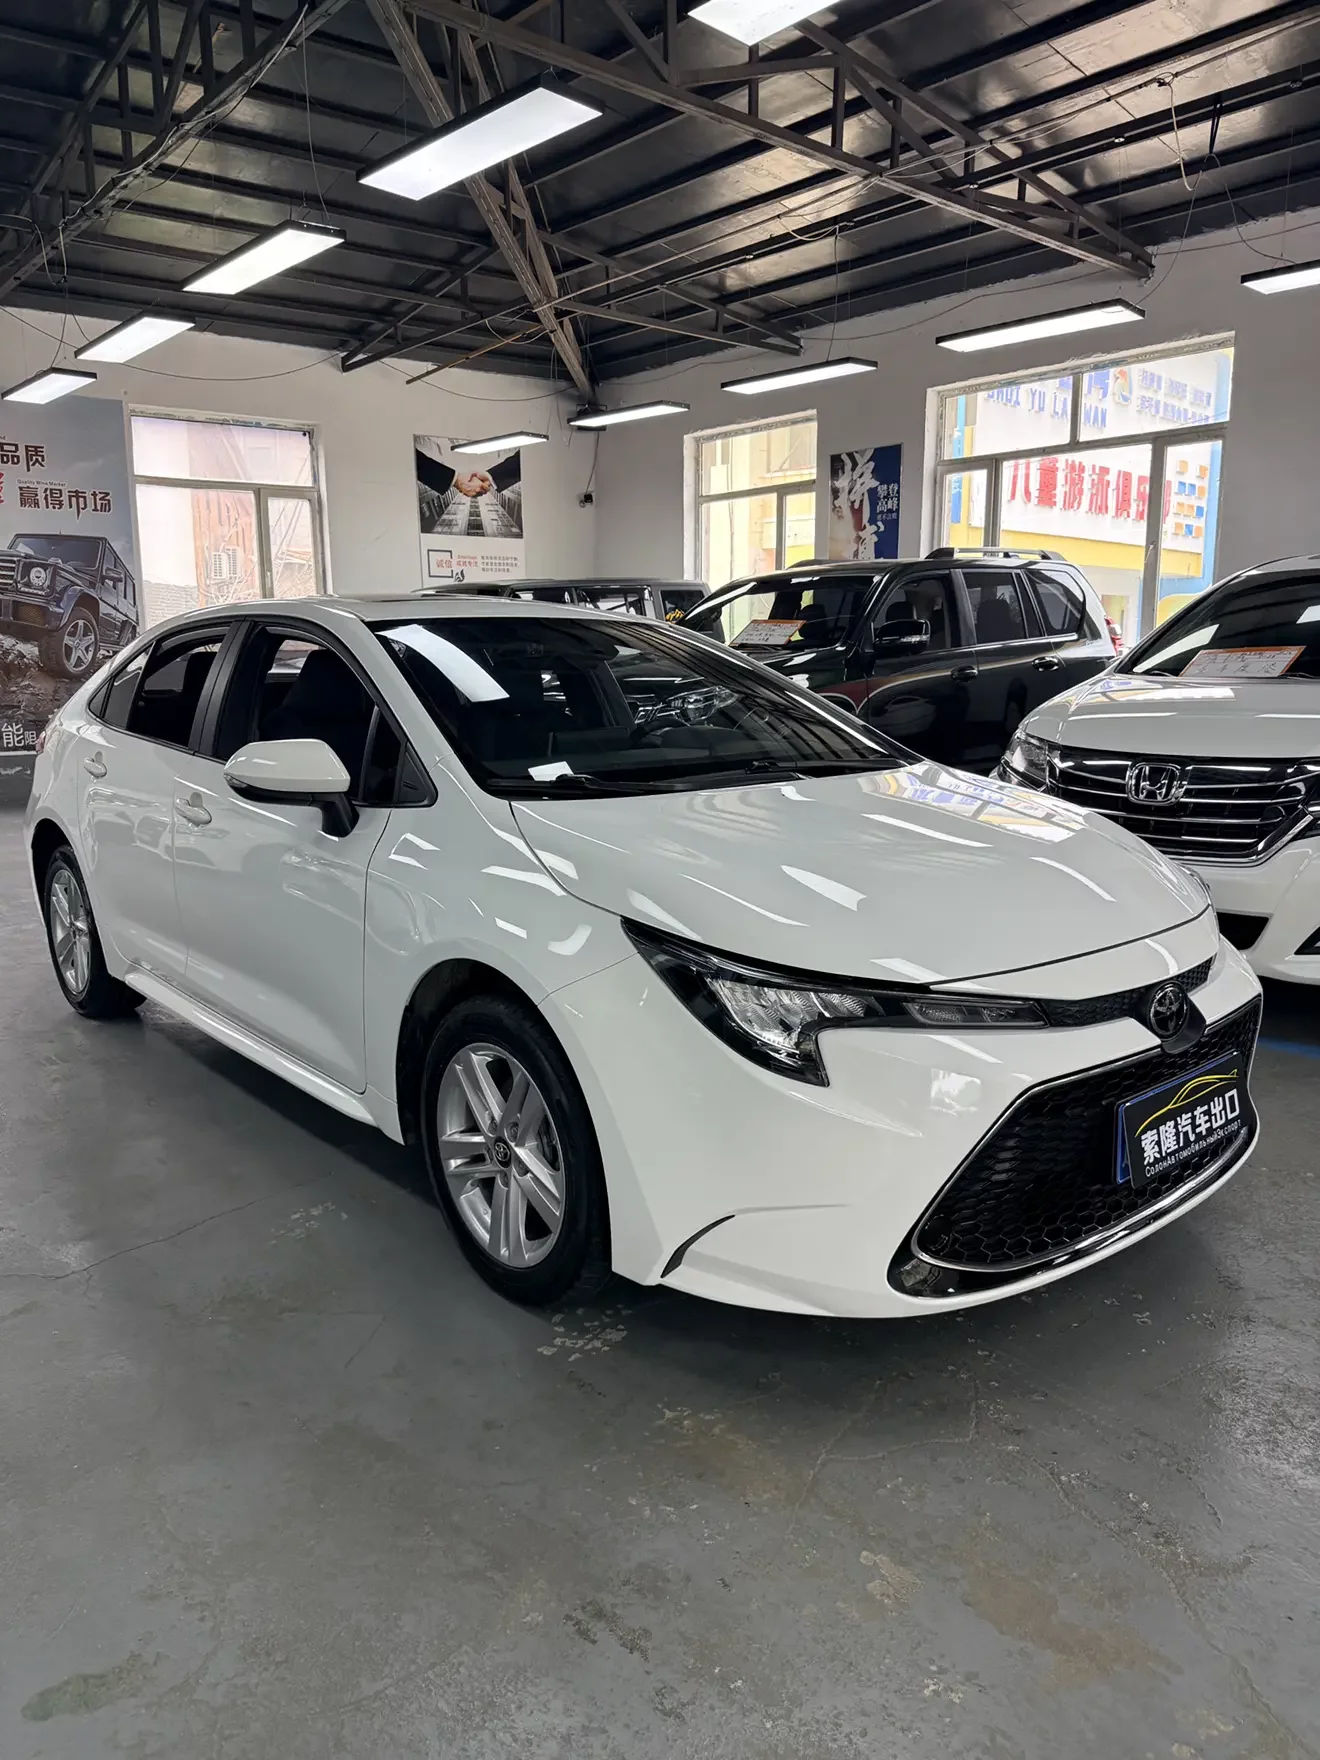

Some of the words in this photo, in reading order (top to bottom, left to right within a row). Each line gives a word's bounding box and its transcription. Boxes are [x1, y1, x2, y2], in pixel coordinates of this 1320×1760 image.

[1030, 388, 1046, 412] YU
[1053, 394, 1069, 418] LA
[1084, 403, 1107, 428] WAN
[0, 442, 46, 472] 品质
[18, 486, 111, 520] 赢得市场
[1010, 457, 1172, 524] 儿童游泳俱乐
[1141, 1088, 1240, 1165] 索隆汽车出口
